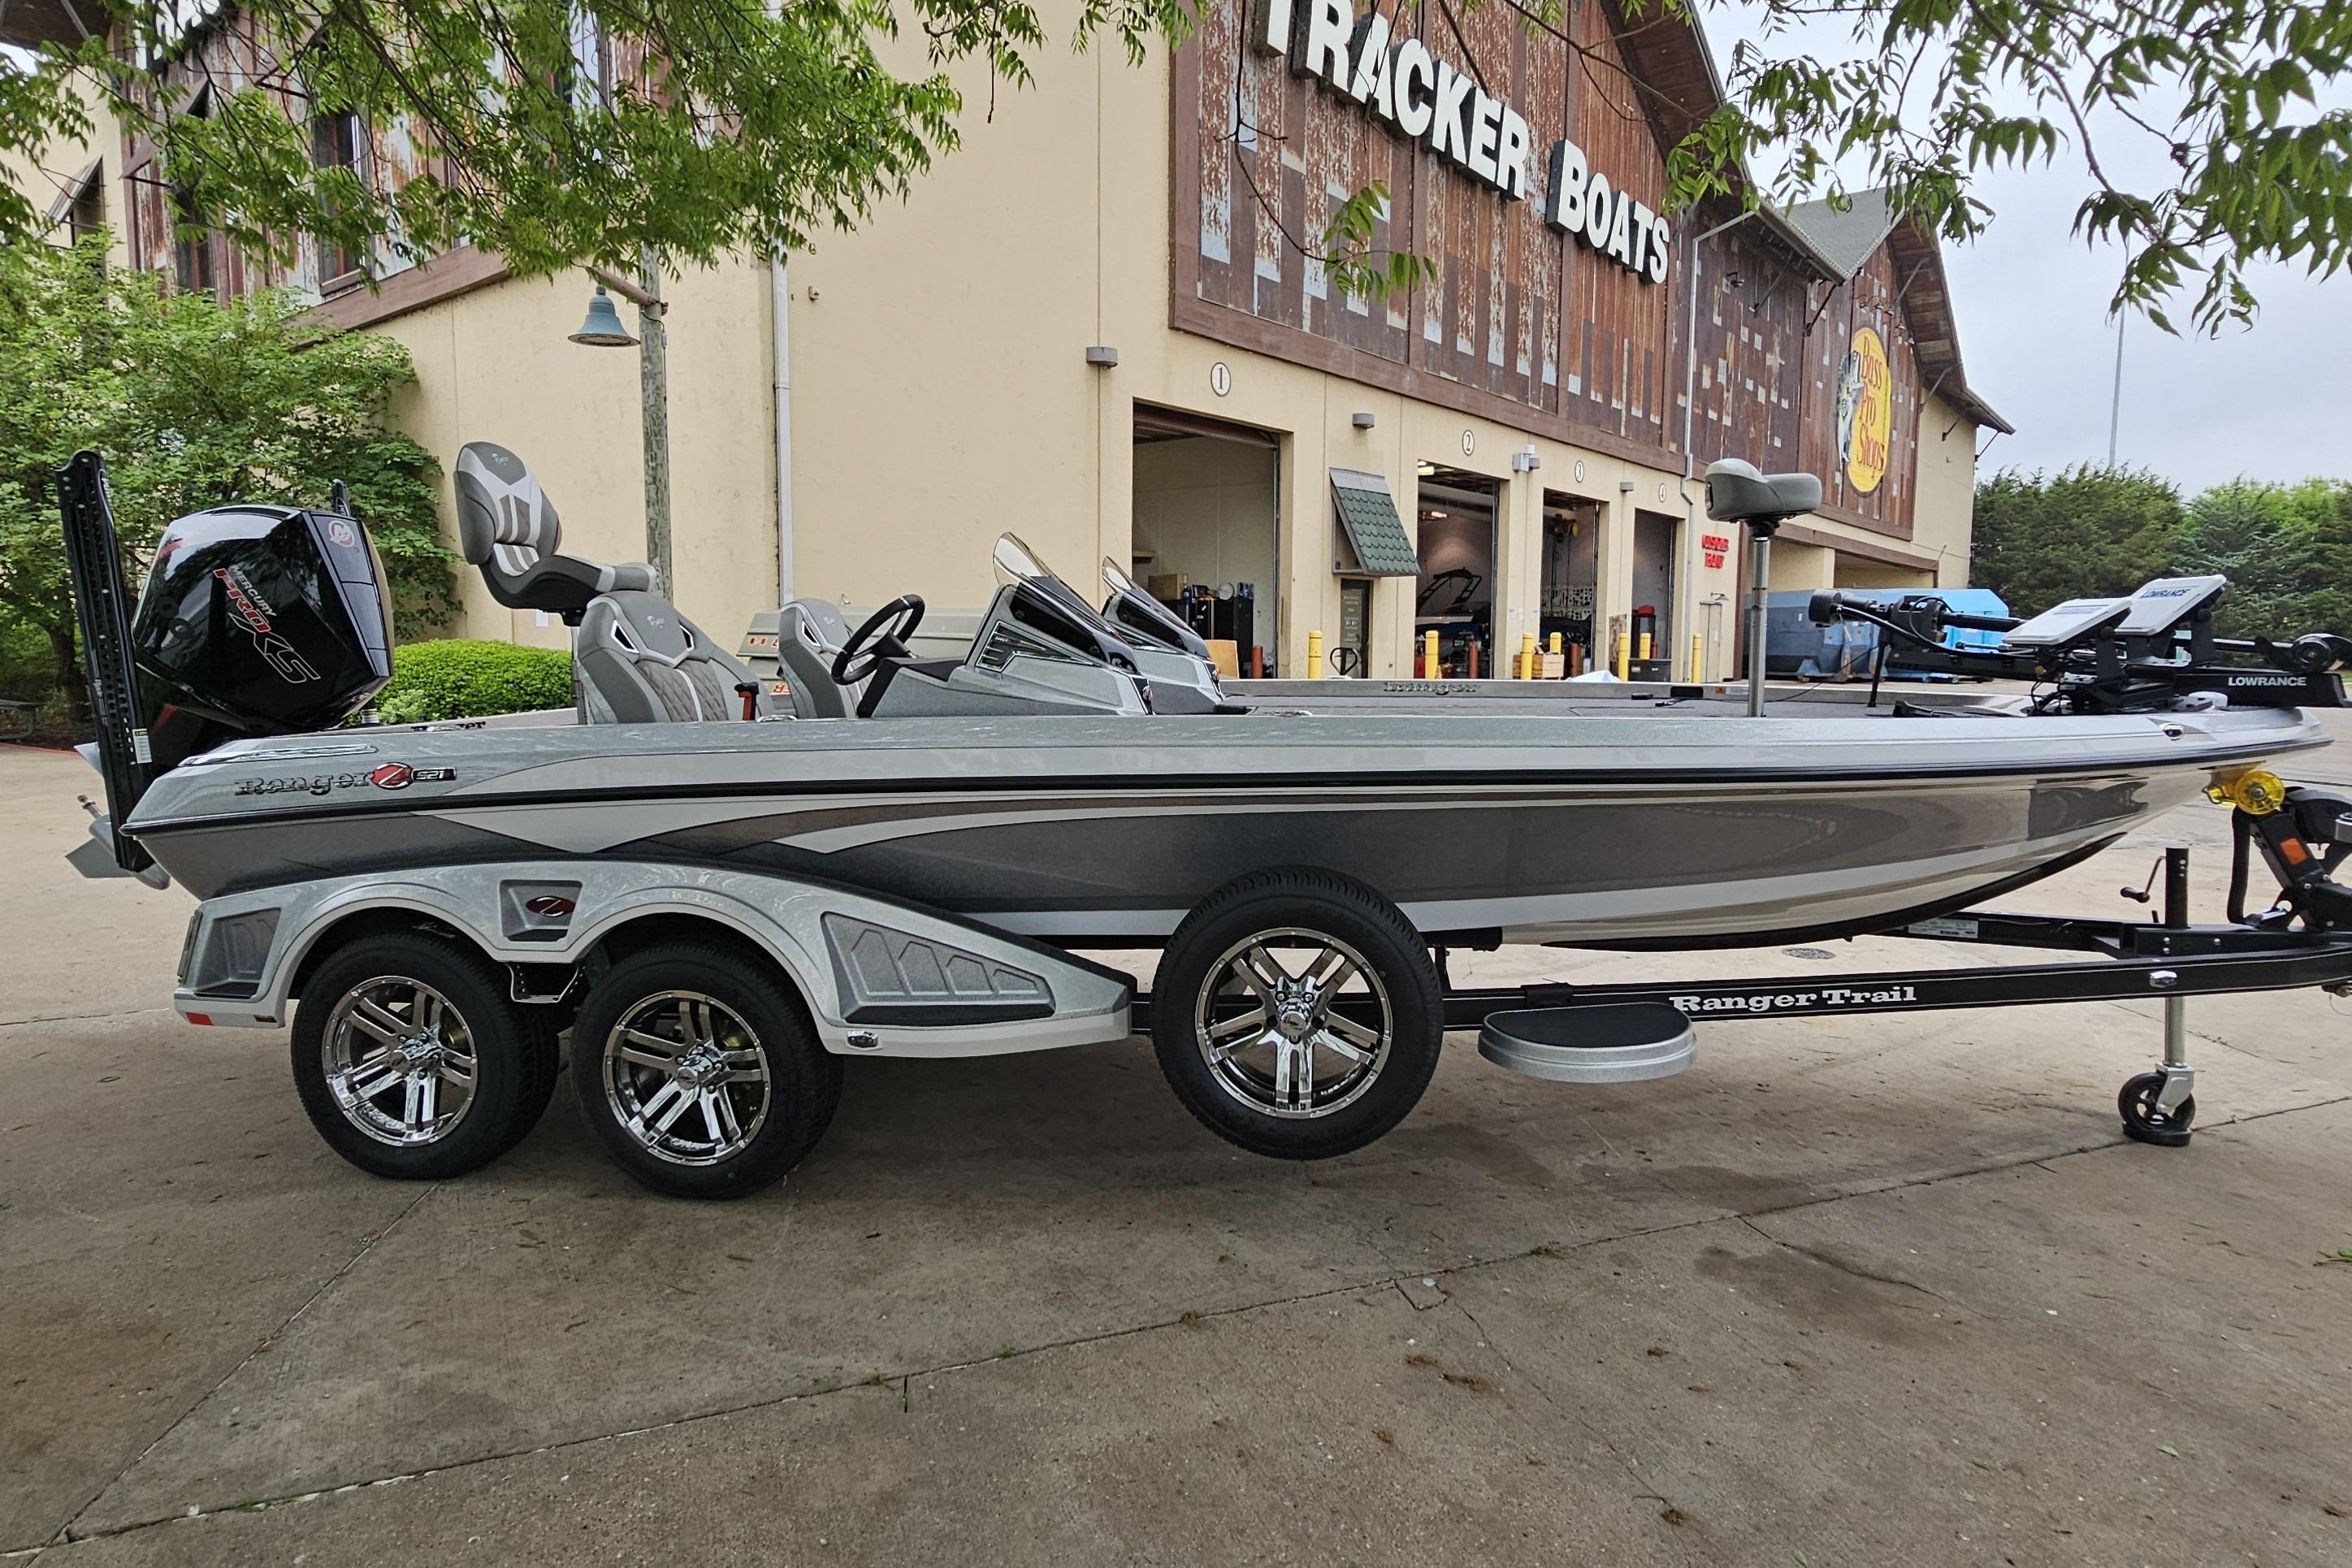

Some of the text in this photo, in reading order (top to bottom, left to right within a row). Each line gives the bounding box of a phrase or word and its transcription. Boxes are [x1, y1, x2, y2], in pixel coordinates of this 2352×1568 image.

[1557, 139, 1670, 284] BOATS
[1861, 335, 1883, 390] Bass
[1859, 381, 1877, 427] Pro
[1856, 422, 1885, 479] Shops
[227, 564, 277, 617] MERCURY
[213, 568, 321, 683] PRO XS
[1384, 682, 1481, 696] Ranger
[2229, 677, 2307, 687] LOWRANCE
[235, 771, 372, 795] Ranger
[416, 770, 445, 780] 521
[1669, 985, 1917, 1011] Ranger Trail
